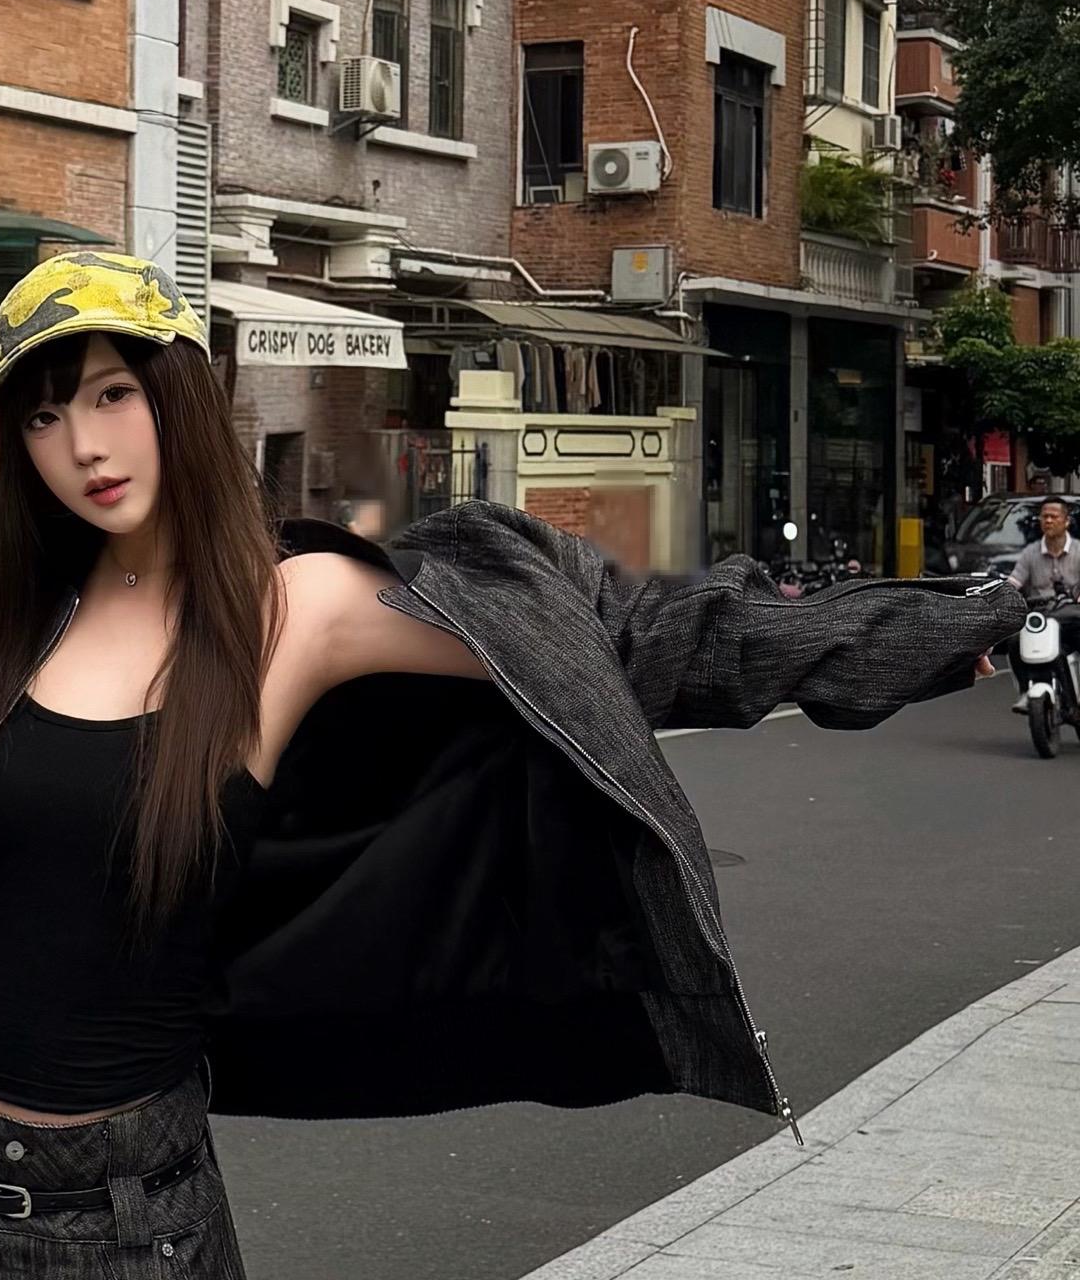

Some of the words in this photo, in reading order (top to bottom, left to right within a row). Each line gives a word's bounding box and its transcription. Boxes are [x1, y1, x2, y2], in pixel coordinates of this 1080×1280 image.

[248, 329, 298, 355] CRISPY
[307, 332, 336, 356] DOG
[345, 333, 391, 357] BAKERY
